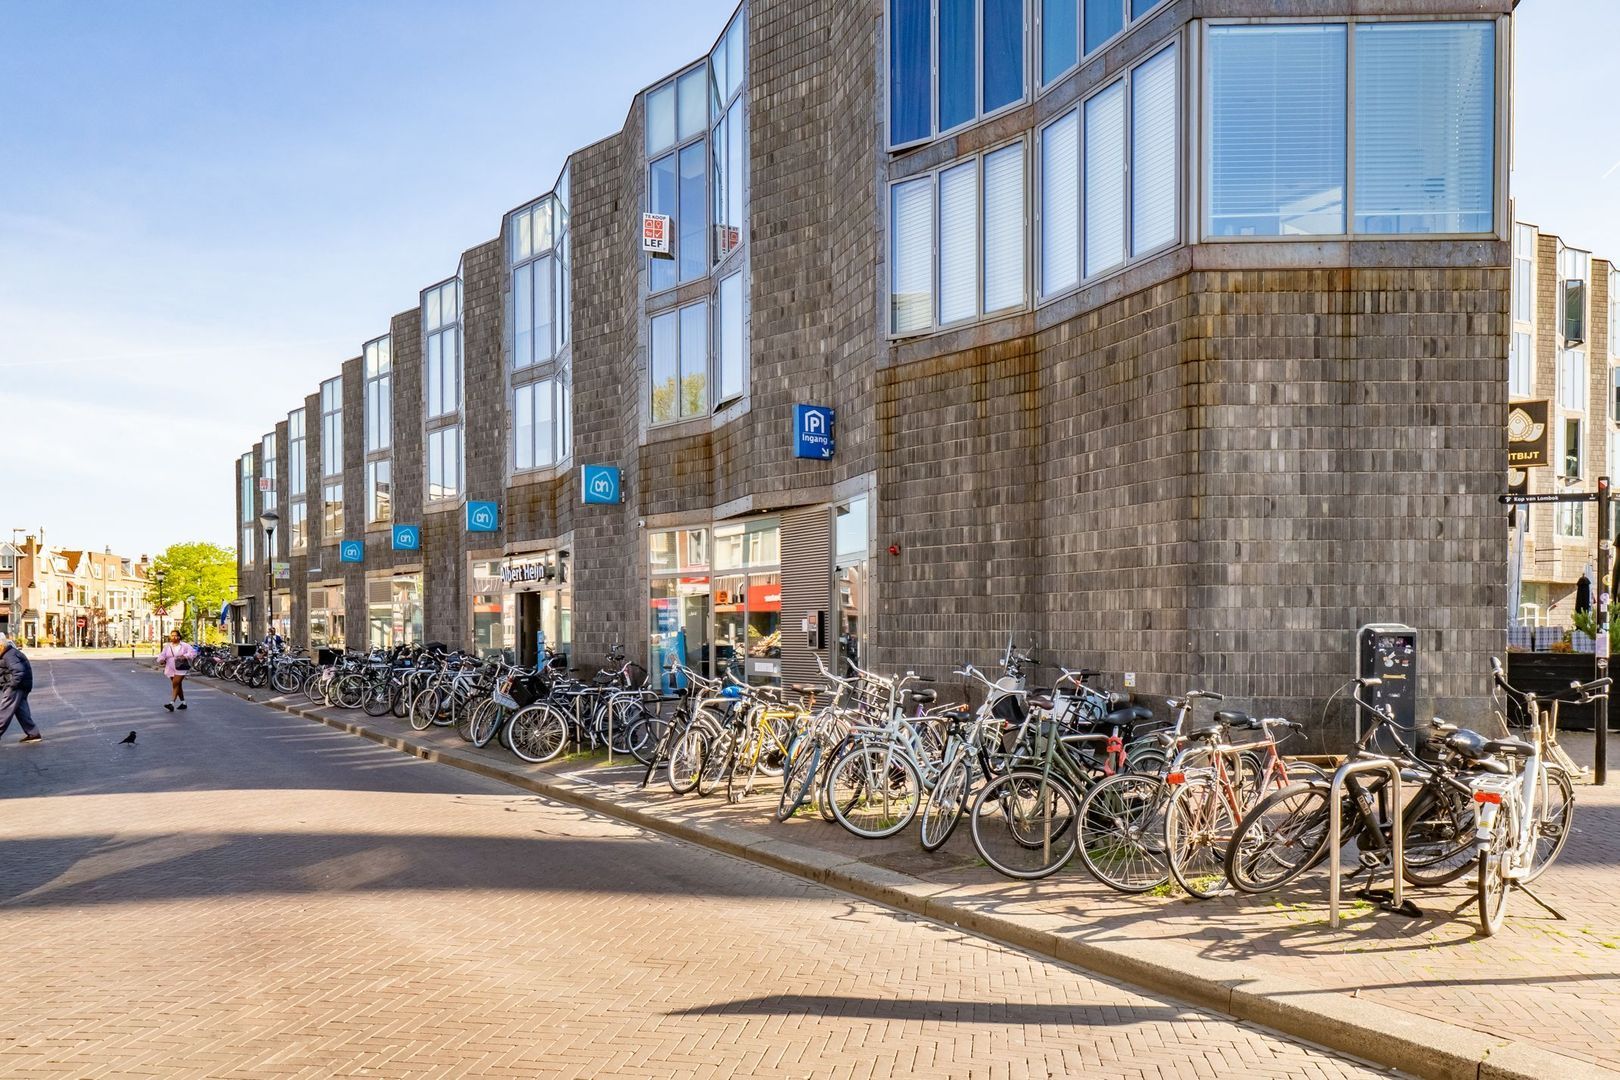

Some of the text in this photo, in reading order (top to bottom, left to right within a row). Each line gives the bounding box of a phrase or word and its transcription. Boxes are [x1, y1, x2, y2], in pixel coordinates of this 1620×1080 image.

[644, 238, 663, 248] LEF
[810, 416, 820, 432] P
[802, 433, 828, 446] Ingang
[1508, 451, 1540, 460] TBIJT
[500, 563, 544, 582] Albert Heijn
